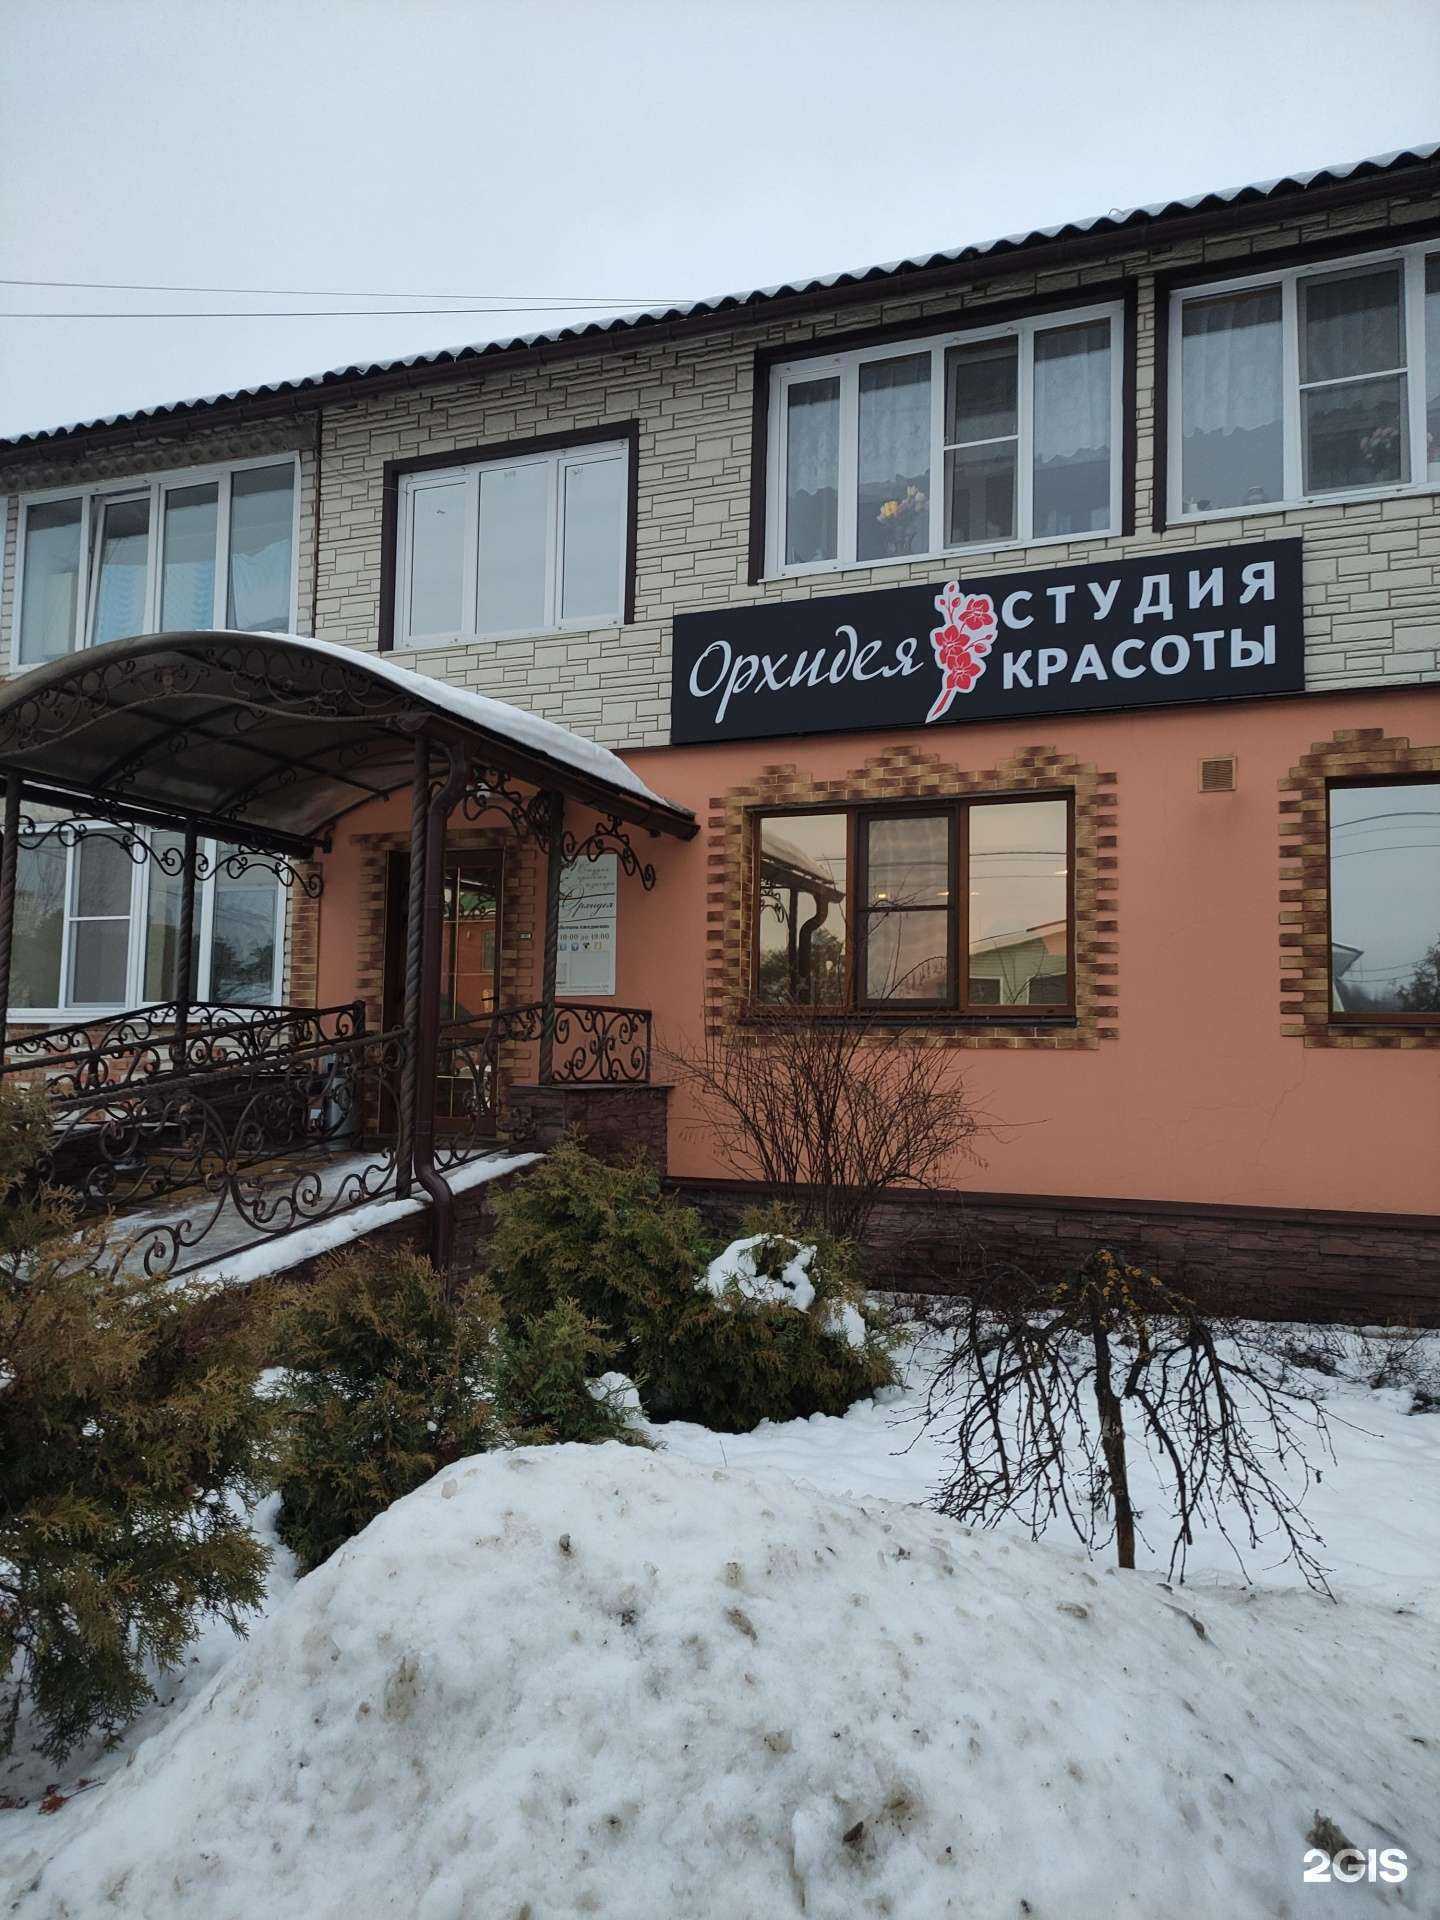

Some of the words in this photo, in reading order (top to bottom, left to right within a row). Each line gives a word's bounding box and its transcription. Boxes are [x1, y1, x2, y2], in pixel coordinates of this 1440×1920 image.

[1001, 561, 1276, 630] СТУДИЯ
[689, 624, 924, 724] Орхидея
[1003, 625, 1276, 690] КРАСОТЫ
